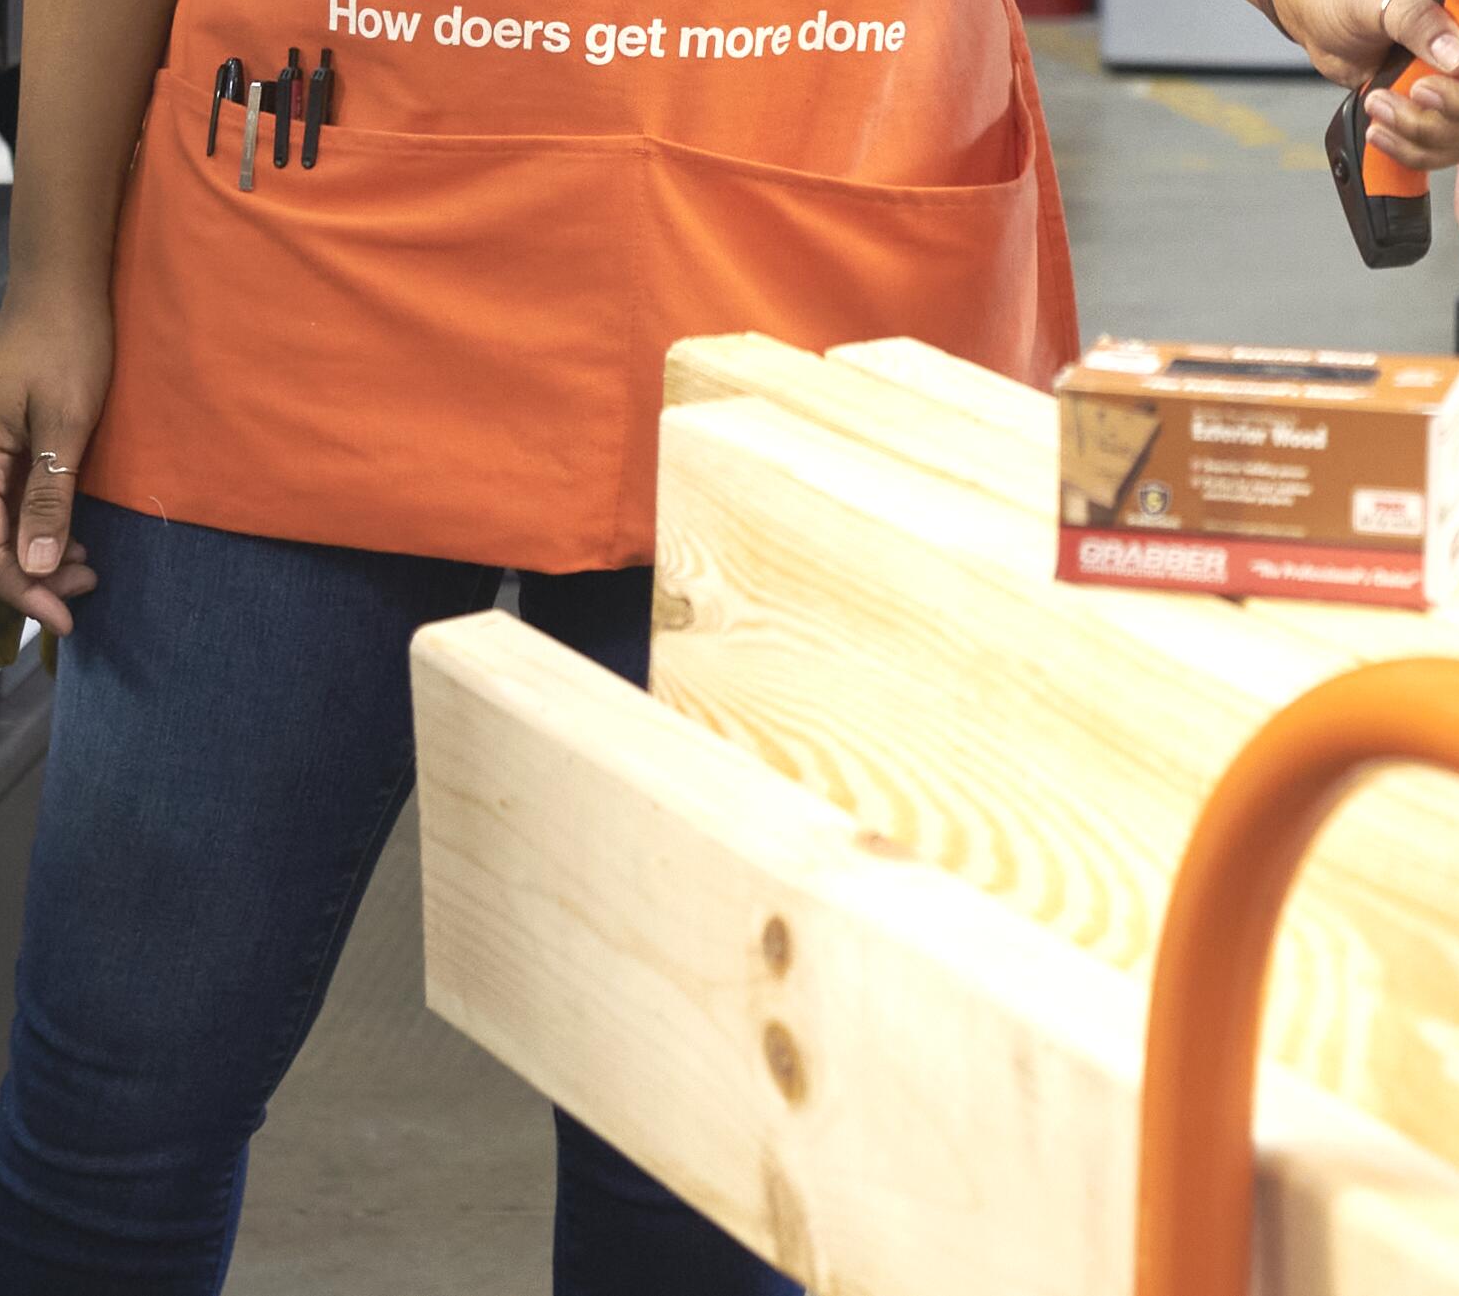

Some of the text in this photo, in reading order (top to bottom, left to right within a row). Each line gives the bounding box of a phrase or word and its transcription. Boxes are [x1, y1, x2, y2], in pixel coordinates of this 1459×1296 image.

[433, 6, 572, 54] doers
[584, 17, 666, 67] get
[678, 22, 792, 60] more
[797, 10, 907, 54] done
[1078, 536, 1229, 574] GRABBER
